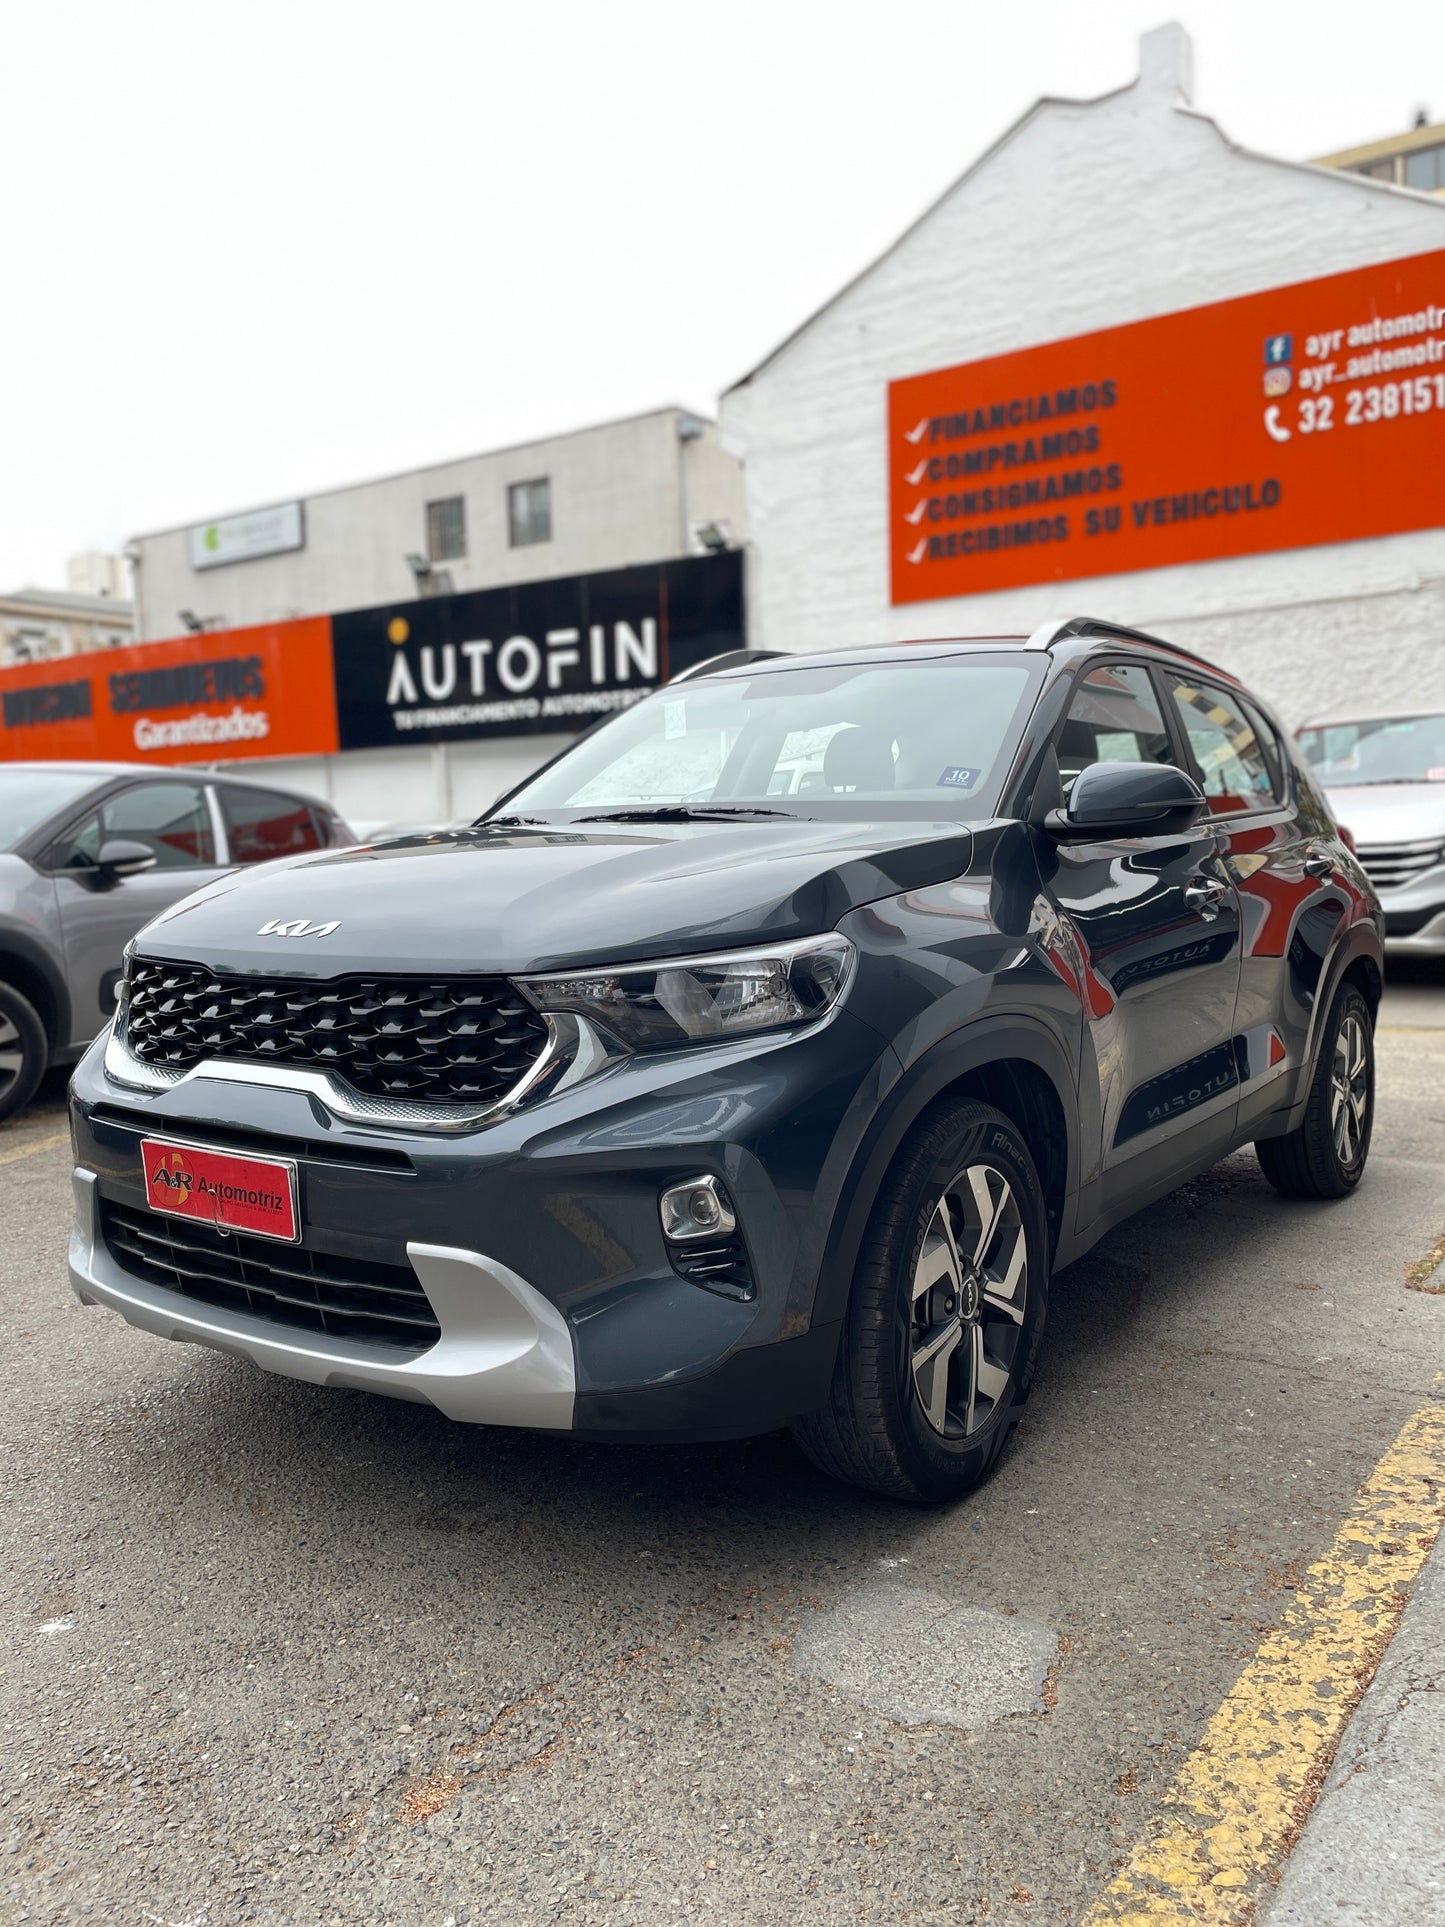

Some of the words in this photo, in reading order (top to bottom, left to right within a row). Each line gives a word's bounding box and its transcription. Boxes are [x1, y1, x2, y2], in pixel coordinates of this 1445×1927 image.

[1305, 329, 1345, 361] ayr
[928, 379, 1118, 444] FINANCIAMOS
[1298, 394, 1335, 434] 32
[1344, 373, 1445, 426] 238151
[927, 425, 1100, 483] COMPRAMOS
[926, 463, 1122, 522] CONSIGNAMOS
[927, 514, 1069, 560] RECIBIMOS
[1085, 505, 1121, 535] SU
[1131, 478, 1281, 528] VEHICULO
[386, 616, 658, 705] AUTOFIN
[133, 704, 269, 750] Garantizados
[951, 769, 971, 780] 10
[256, 918, 343, 939] KIA
[152, 1167, 193, 1192] A&R
[197, 1176, 284, 1211] Automotriz
